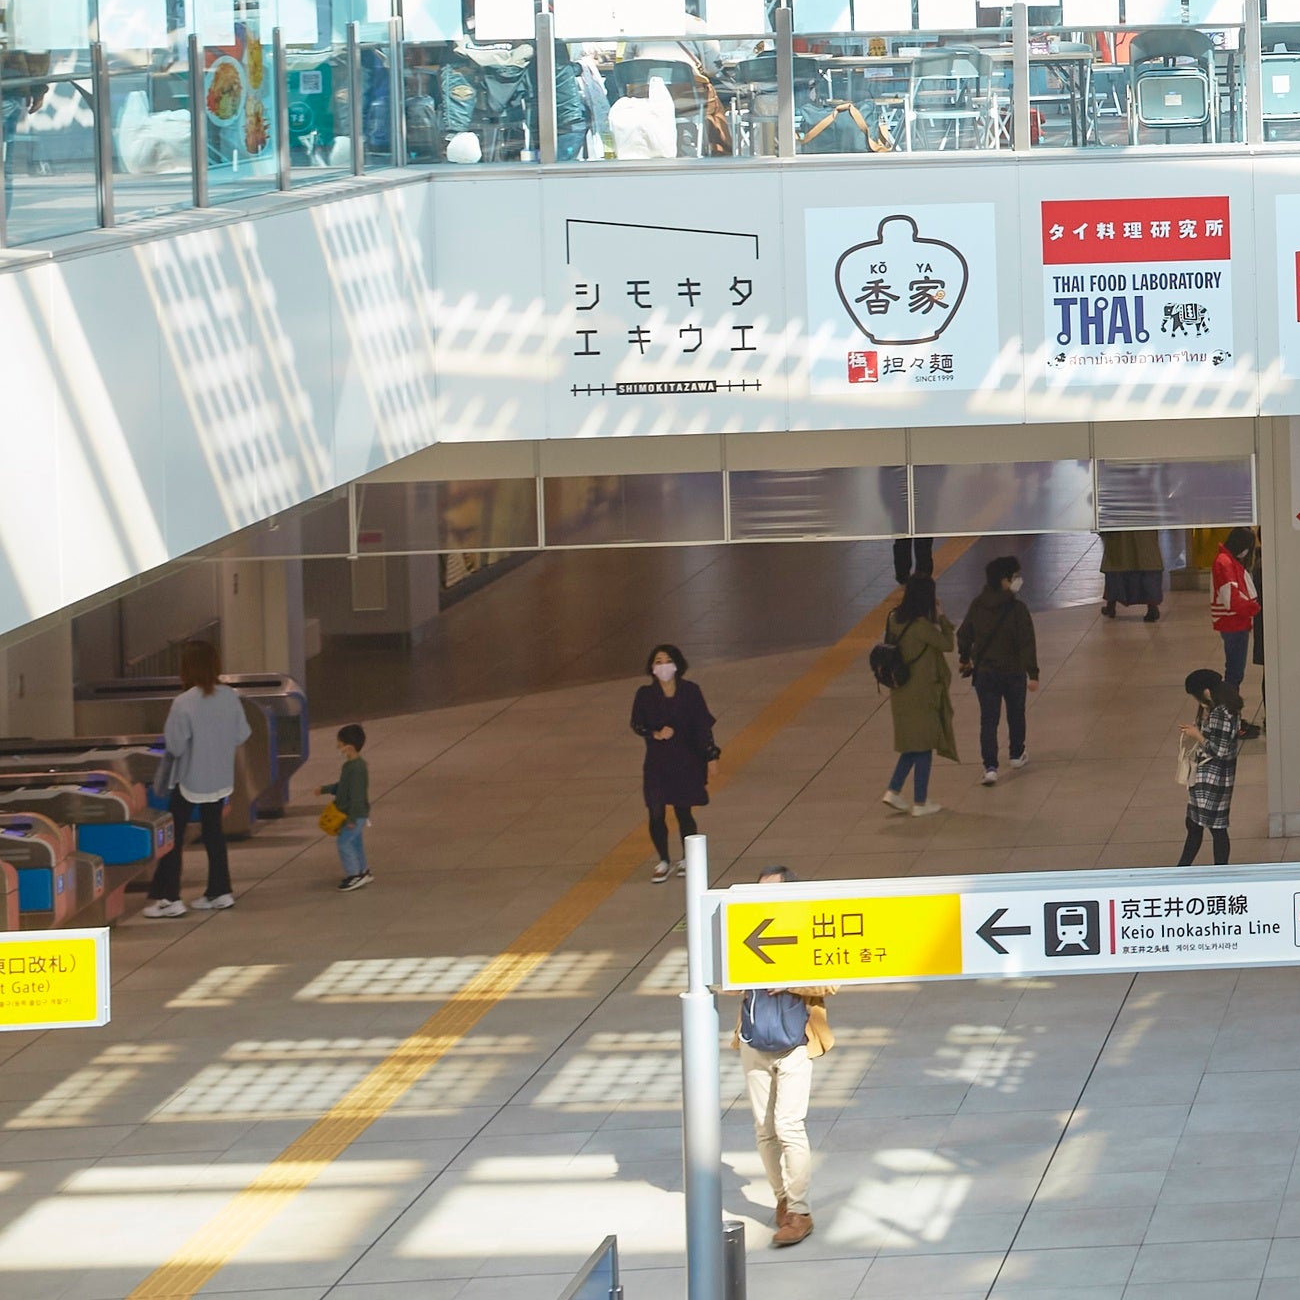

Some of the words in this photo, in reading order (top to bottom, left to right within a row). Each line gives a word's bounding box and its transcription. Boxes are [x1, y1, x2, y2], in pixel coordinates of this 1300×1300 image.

[1048, 219, 1224, 242] タイ料理研究所
[916, 262, 934, 274] YA
[575, 276, 754, 311] シモキタ
[1053, 274, 1085, 294] THAI
[1090, 274, 1127, 292] FOOD
[1132, 272, 1222, 291] LABORATORY
[854, 275, 950, 315] 香家
[1053, 295, 1150, 346] THAI
[573, 323, 758, 356] エキウエ
[617, 381, 716, 395] SHIMOKITAZAWA
[915, 375, 936, 383] SINCE
[1121, 894, 1249, 920] 京王井の頭線
[812, 913, 864, 940] 出口
[1121, 924, 1155, 940] Keio
[1161, 921, 1242, 939] Inokashira
[1248, 919, 1281, 935] Line
[813, 946, 850, 966] Exit
[859, 947, 887, 963] 출구
[1122, 944, 1170, 954] 京王井之头线
[11, 979, 50, 994] Gate)
